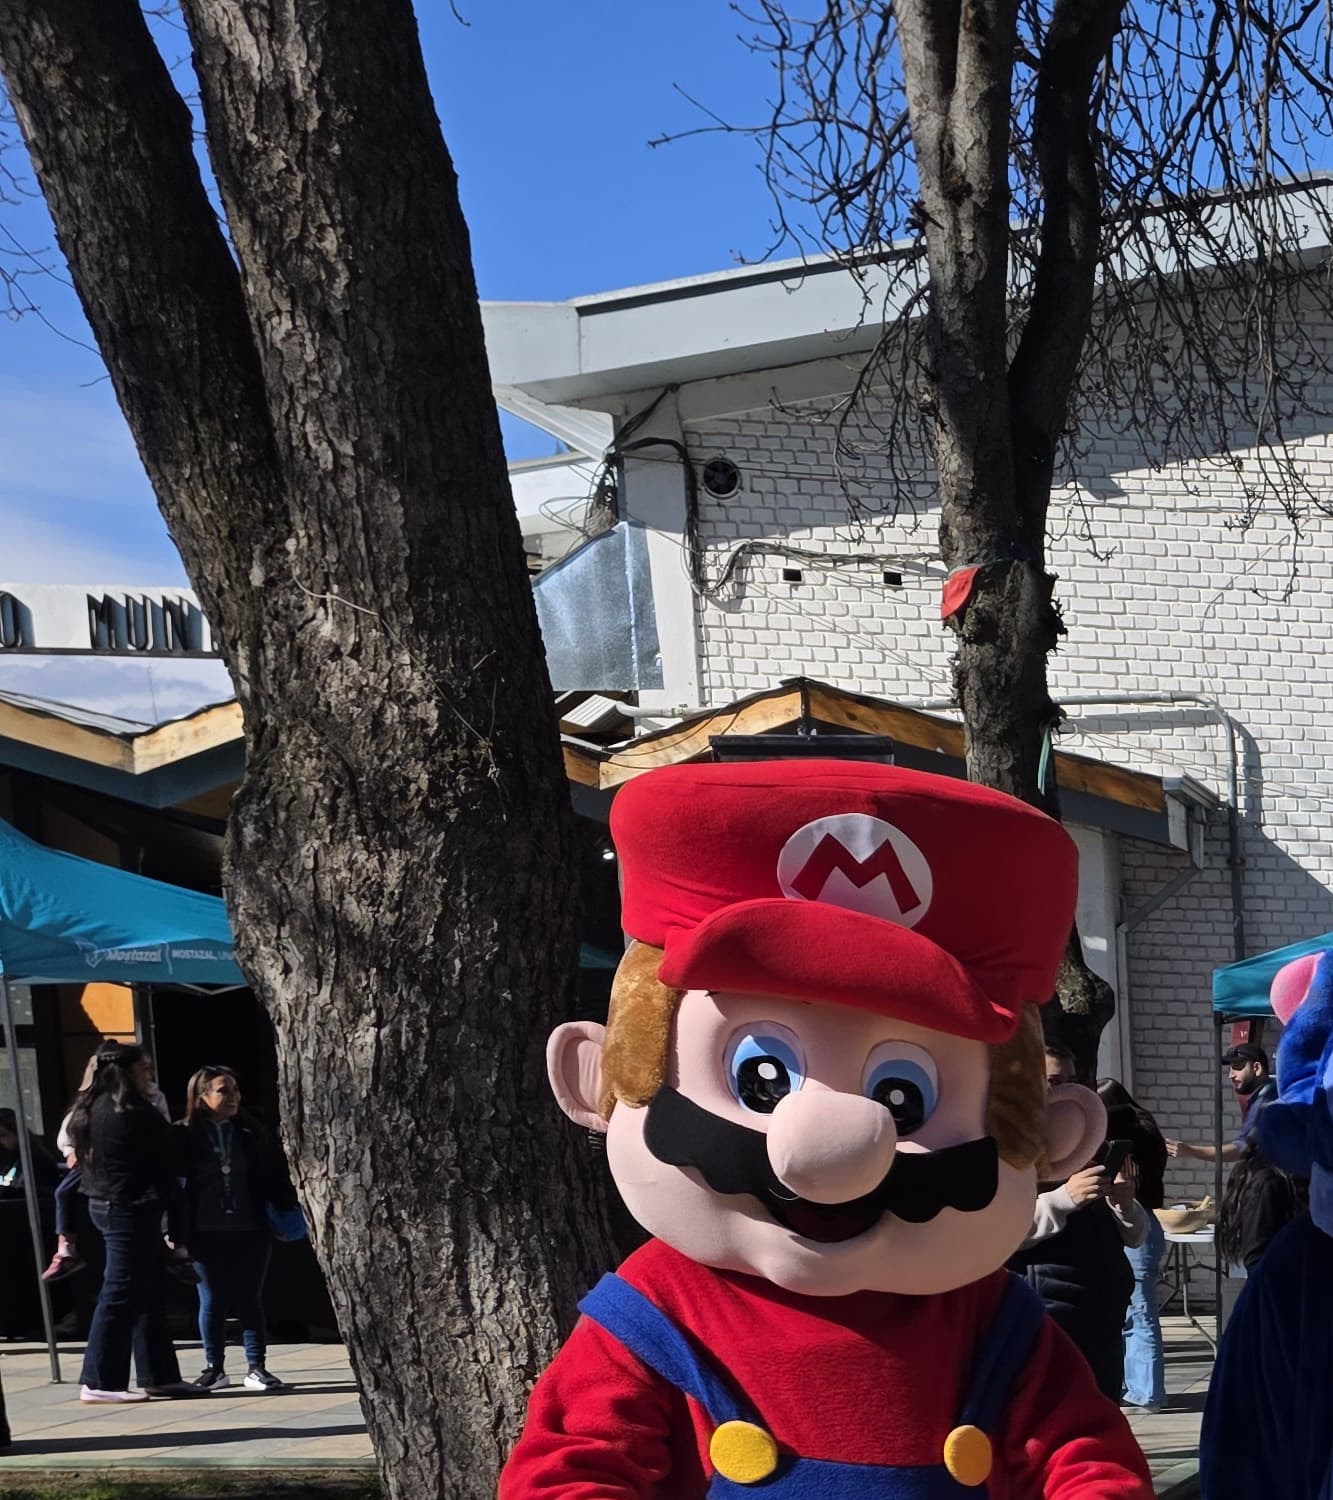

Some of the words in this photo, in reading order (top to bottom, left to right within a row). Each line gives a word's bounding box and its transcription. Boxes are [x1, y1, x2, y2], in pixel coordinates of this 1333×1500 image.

[86, 593, 196, 651] MUN
[790, 832, 922, 915] M
[105, 949, 162, 962] Mostazal
